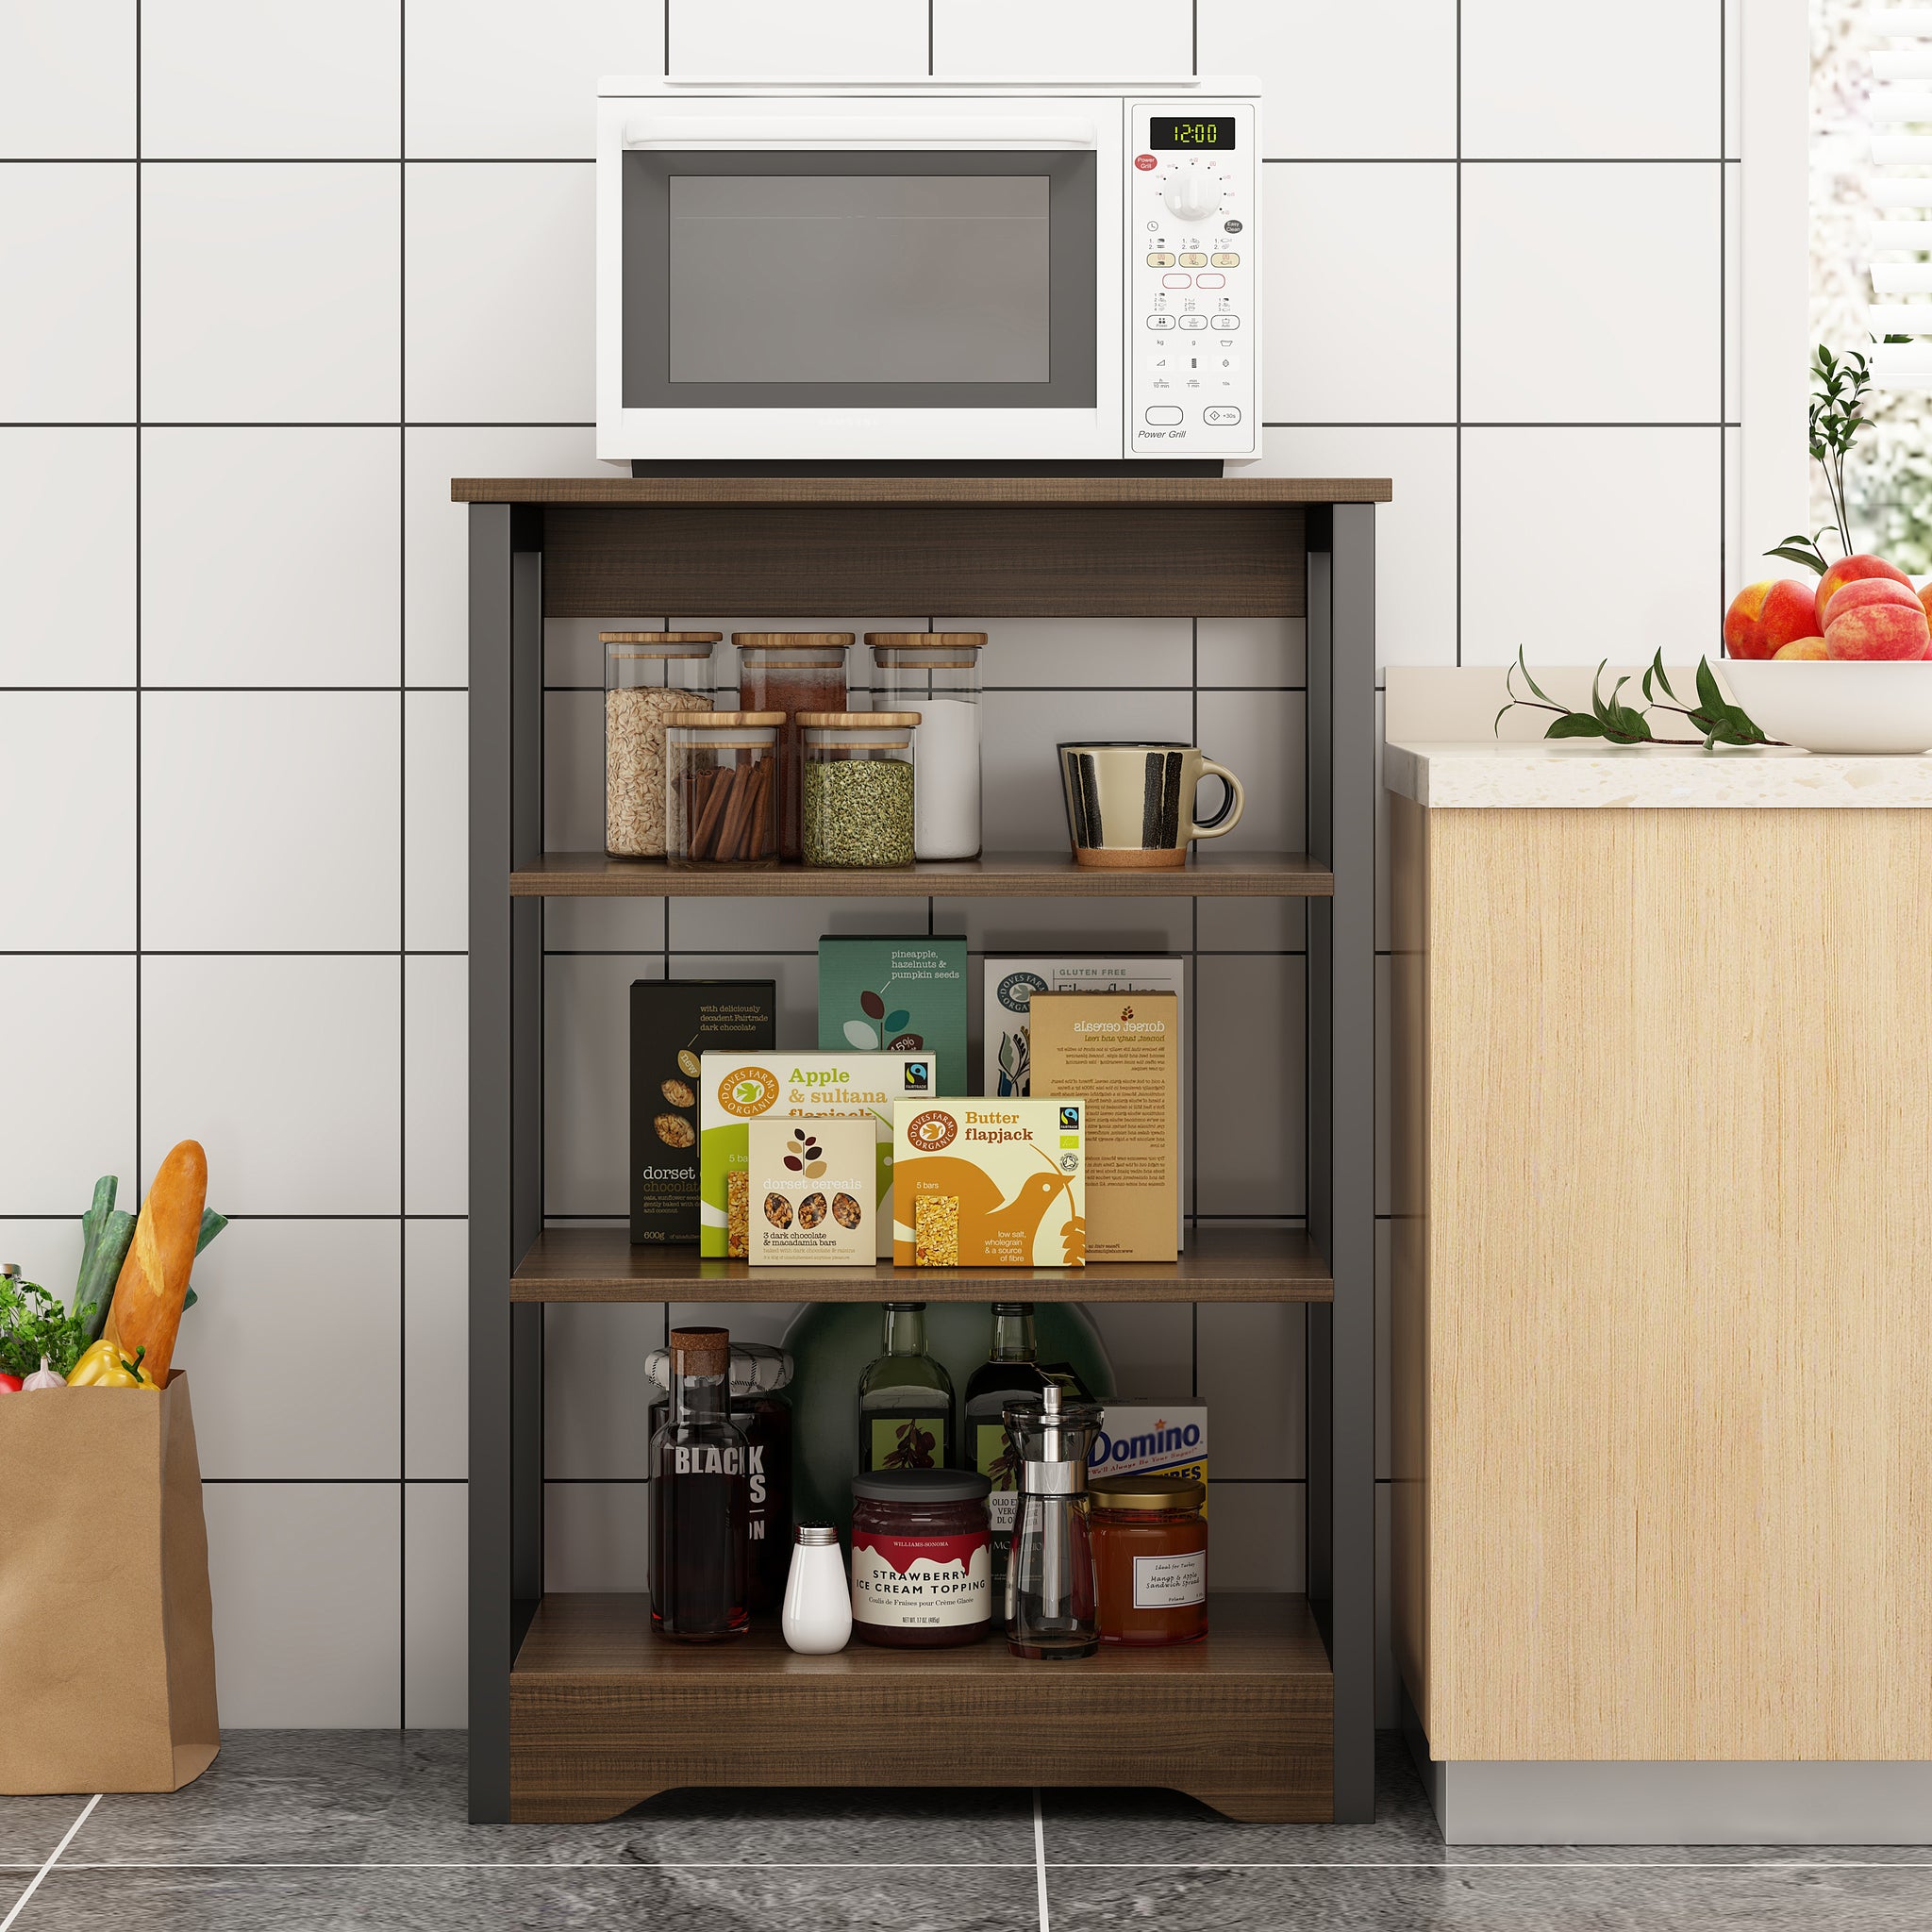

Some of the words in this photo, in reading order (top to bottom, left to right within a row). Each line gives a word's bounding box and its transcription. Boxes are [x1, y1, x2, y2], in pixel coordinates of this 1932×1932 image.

[1174, 124, 1217, 143] 12:00
[1138, 430, 1167, 439] Power
[1168, 430, 1187, 439] Grill
[891, 950, 939, 959] pineapple,
[891, 971, 932, 979] pumpkin
[1000, 974, 1024, 995] DOVES
[1026, 975, 1045, 991] FAR
[719, 1005, 761, 1013] deliciously
[1003, 997, 1029, 1011] ORGA
[680, 1053, 698, 1075] new
[789, 1068, 850, 1087] Apple
[721, 1072, 746, 1101] DOVES
[748, 1069, 774, 1091] FARM
[789, 1089, 805, 1104] &
[810, 1089, 889, 1104] sultana
[726, 1091, 775, 1116] ORGANIC
[965, 1111, 1020, 1124] Butter
[910, 1113, 932, 1139] DOVES
[933, 1112, 955, 1131] FARM
[915, 1131, 954, 1150] ORGANIC
[965, 1128, 1034, 1144] flapjack
[643, 1166, 696, 1180] dorset
[643, 1181, 700, 1192] chocolat
[763, 1178, 808, 1190] dorset
[811, 1178, 862, 1190] cereals
[643, 1231, 665, 1241] 600g
[1011, 1230, 1026, 1239] salt,
[984, 1239, 1023, 1247] wholegrain
[1088, 1423, 1200, 1468] Domino
[992, 1498, 1009, 1507] OLIO
[873, 1570, 966, 1581] STRAWBERRY
[1183, 1572, 1198, 1581] Apple
[856, 1579, 870, 1591] ICE
[874, 1583, 924, 1594] CREAM
[930, 1579, 985, 1594] TOPPING
[1182, 1577, 1200, 1588] Spread
